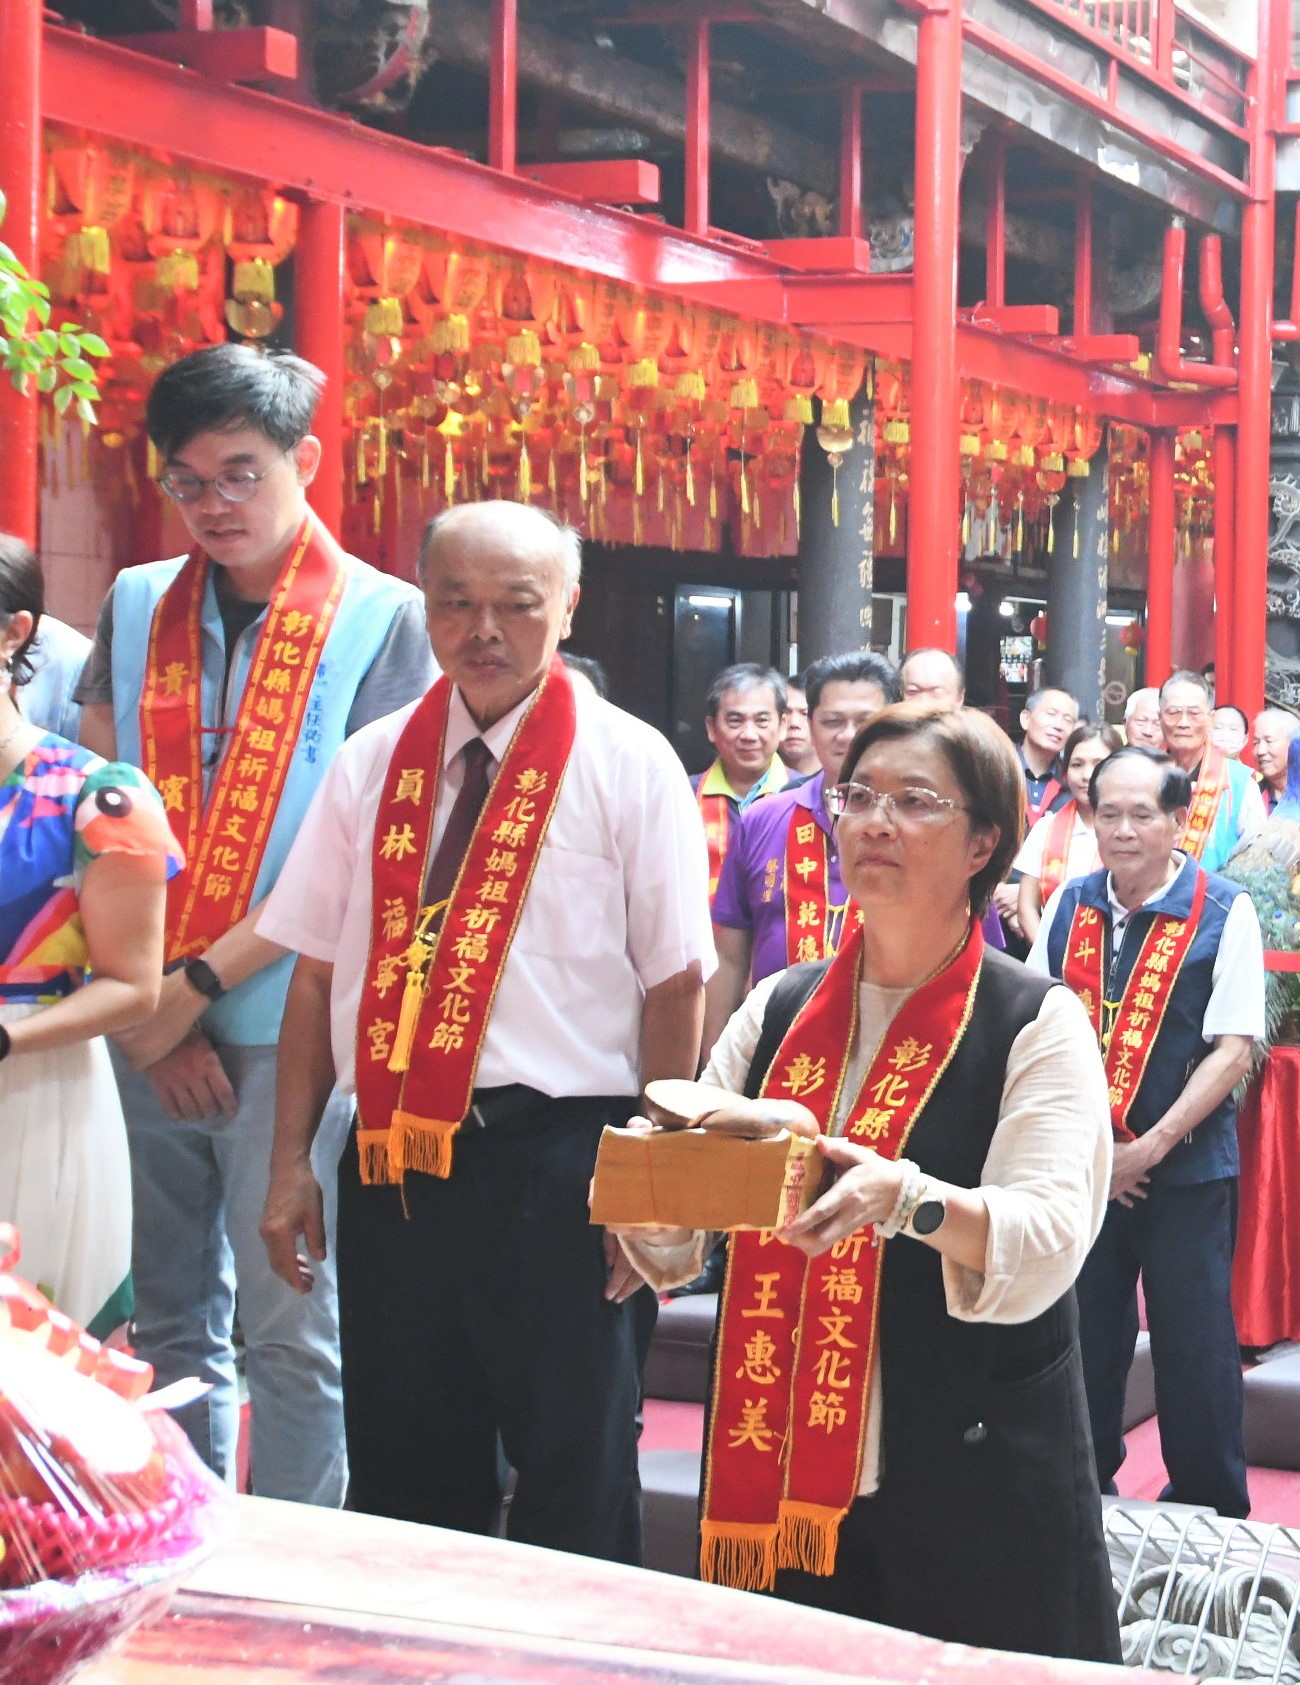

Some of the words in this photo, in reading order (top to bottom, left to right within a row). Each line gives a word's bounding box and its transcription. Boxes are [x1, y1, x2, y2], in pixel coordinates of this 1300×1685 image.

[159, 661, 190, 813] 貴賓
[203, 610, 312, 902] 彰化縣媽祖祈福文化節
[428, 767, 548, 1055] 彰化縣媽祖祈福文化節
[1108, 920, 1187, 1107] 彰化縣媽祖祈福文化節
